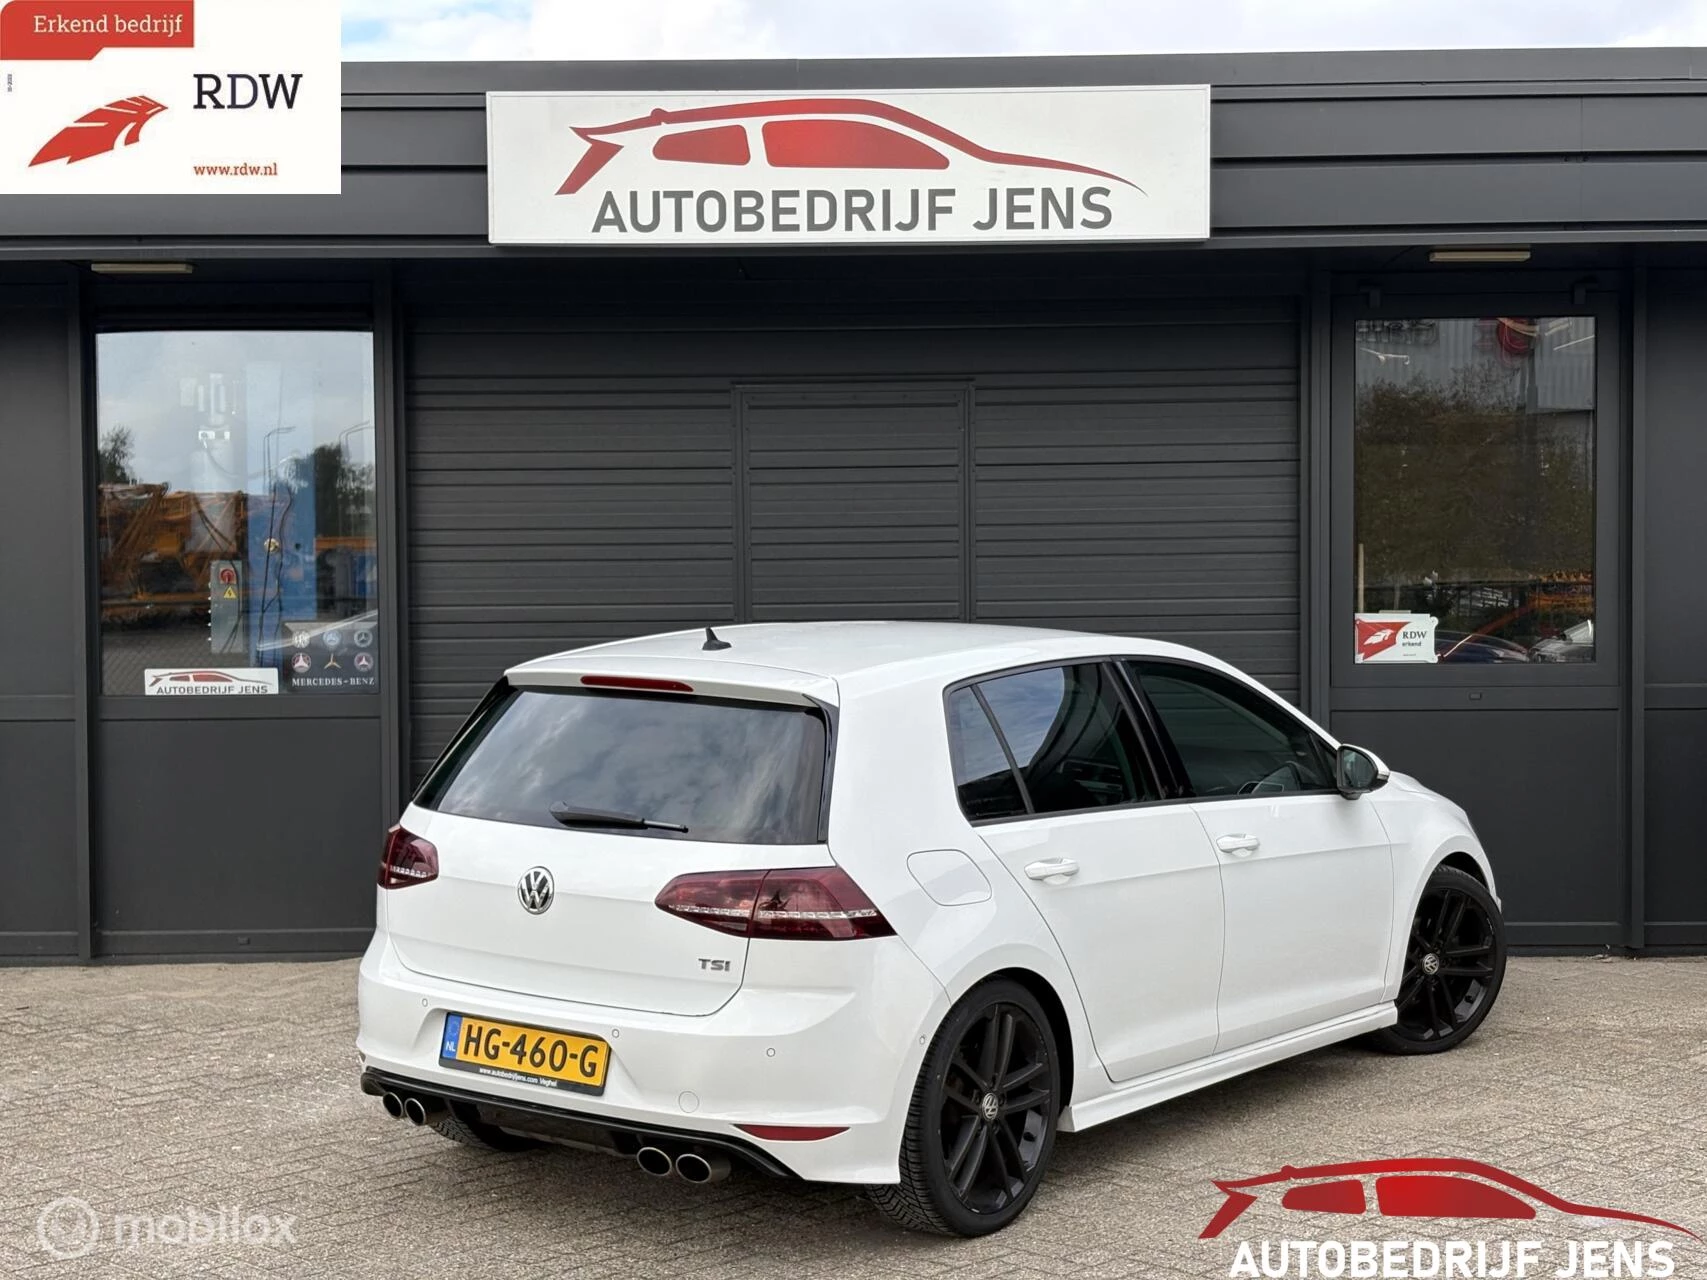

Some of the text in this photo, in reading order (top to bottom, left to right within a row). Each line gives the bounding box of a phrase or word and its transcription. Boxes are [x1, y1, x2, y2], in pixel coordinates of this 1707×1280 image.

[591, 186, 1113, 233] AUTOBEDRIJF JENS
[1402, 631, 1427, 639] RDW
[156, 685, 268, 694] AUTOBEDRIJF JENS
[698, 958, 731, 972] TSI
[445, 1041, 456, 1053] NL
[463, 1024, 599, 1078] HG-460-G
